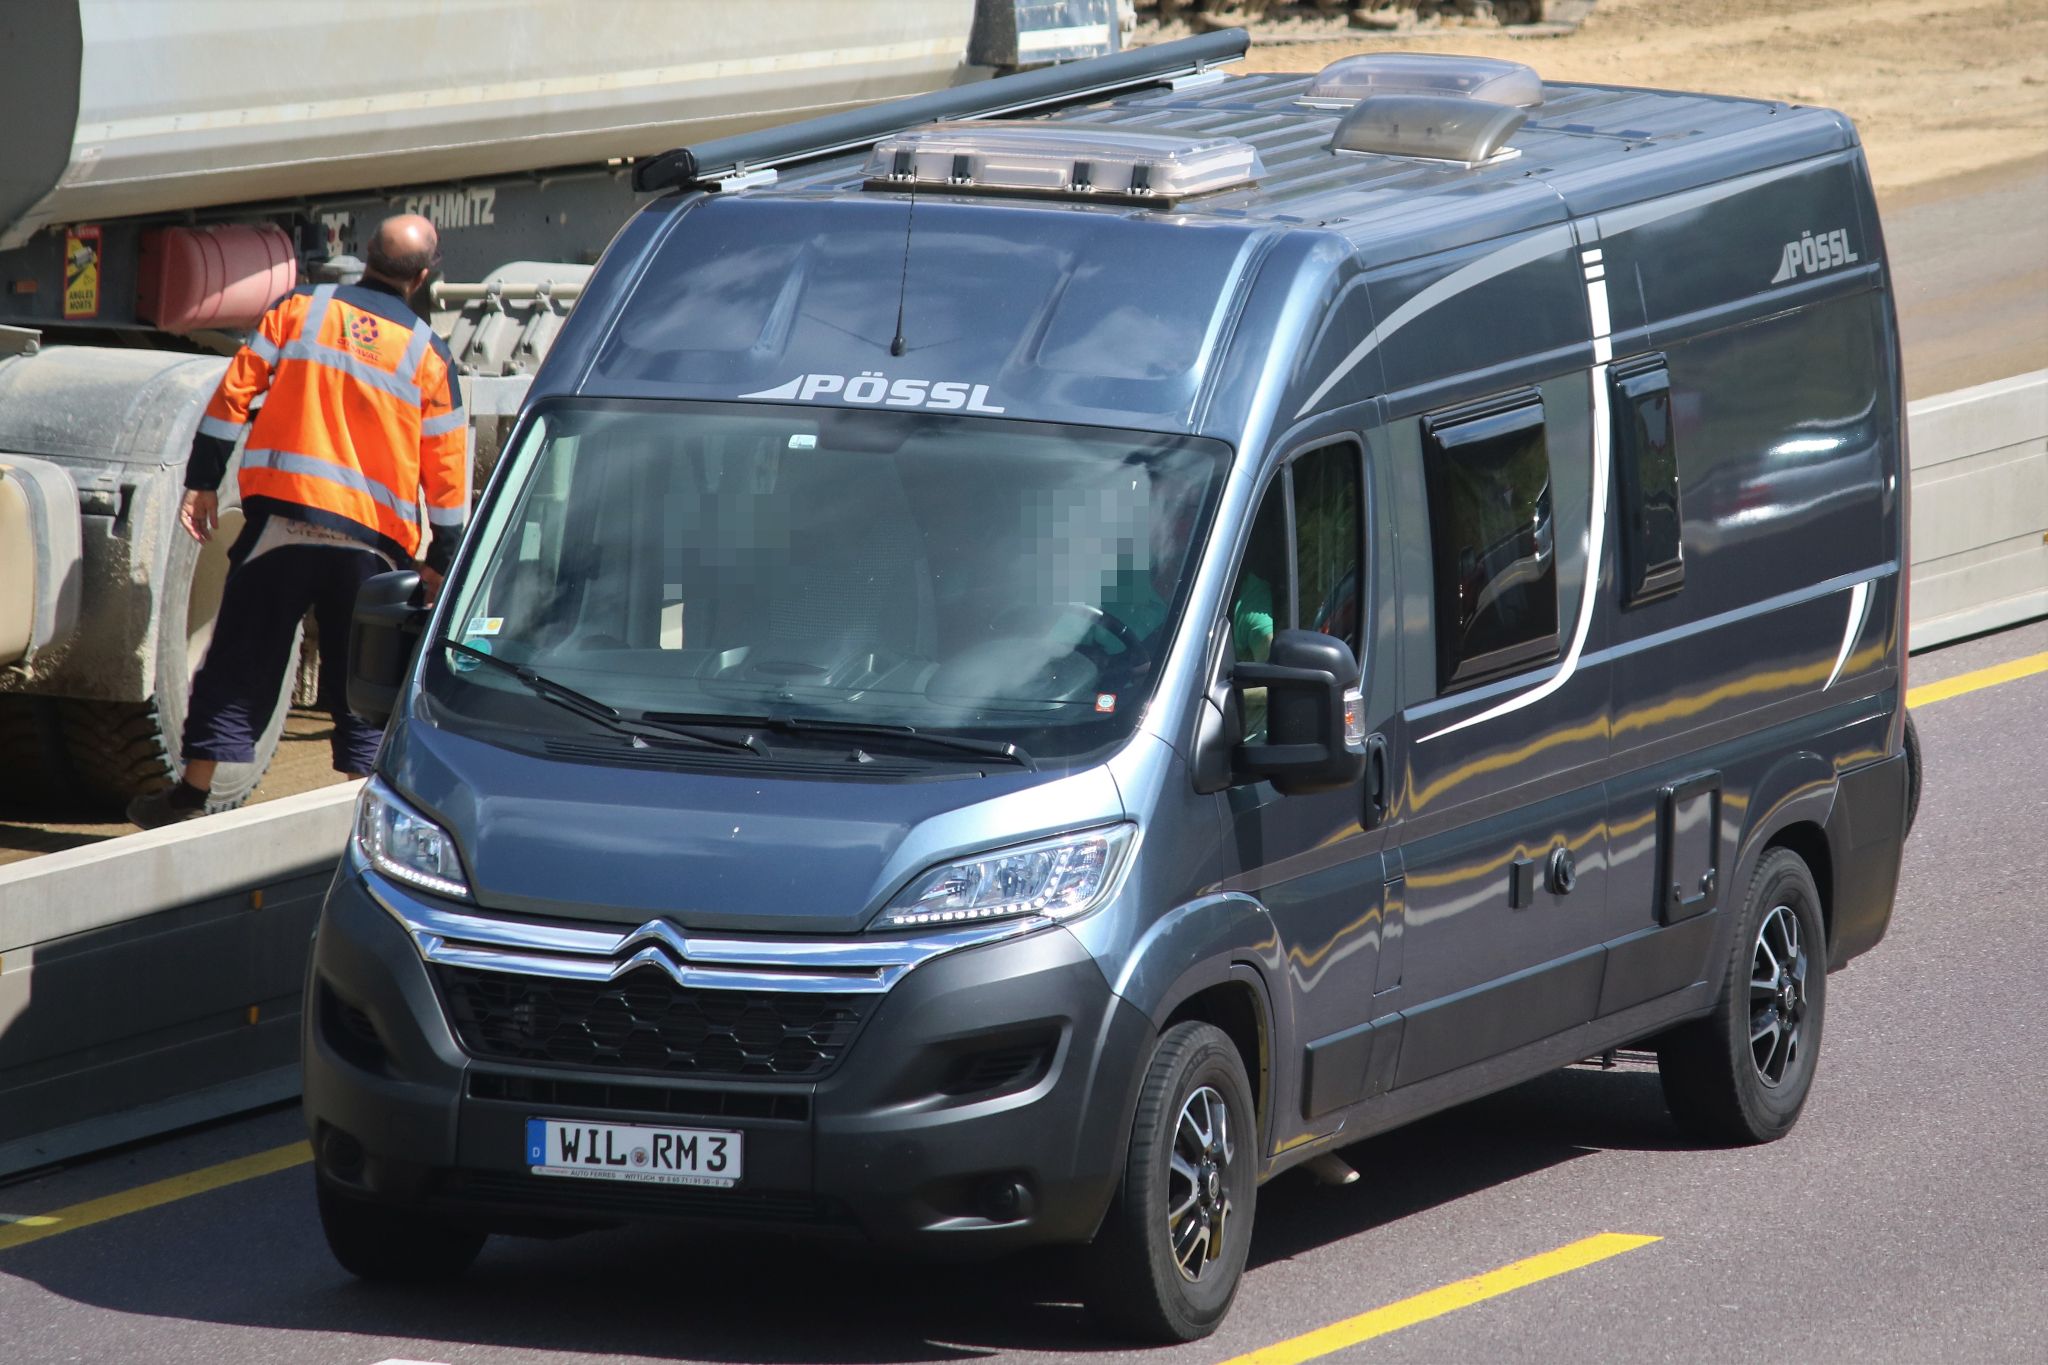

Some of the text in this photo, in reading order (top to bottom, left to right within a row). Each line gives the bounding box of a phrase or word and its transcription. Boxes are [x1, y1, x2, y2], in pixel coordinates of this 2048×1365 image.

[1786, 228, 1859, 278] PÖSSL
[70, 290, 94, 299] ANGLES
[798, 371, 1005, 414] PÖSSL
[532, 1147, 540, 1158] D
[560, 1127, 728, 1173] WIL RM 3
[570, 1170, 589, 1178] AUTO
[624, 1173, 655, 1181] WITTLICH
